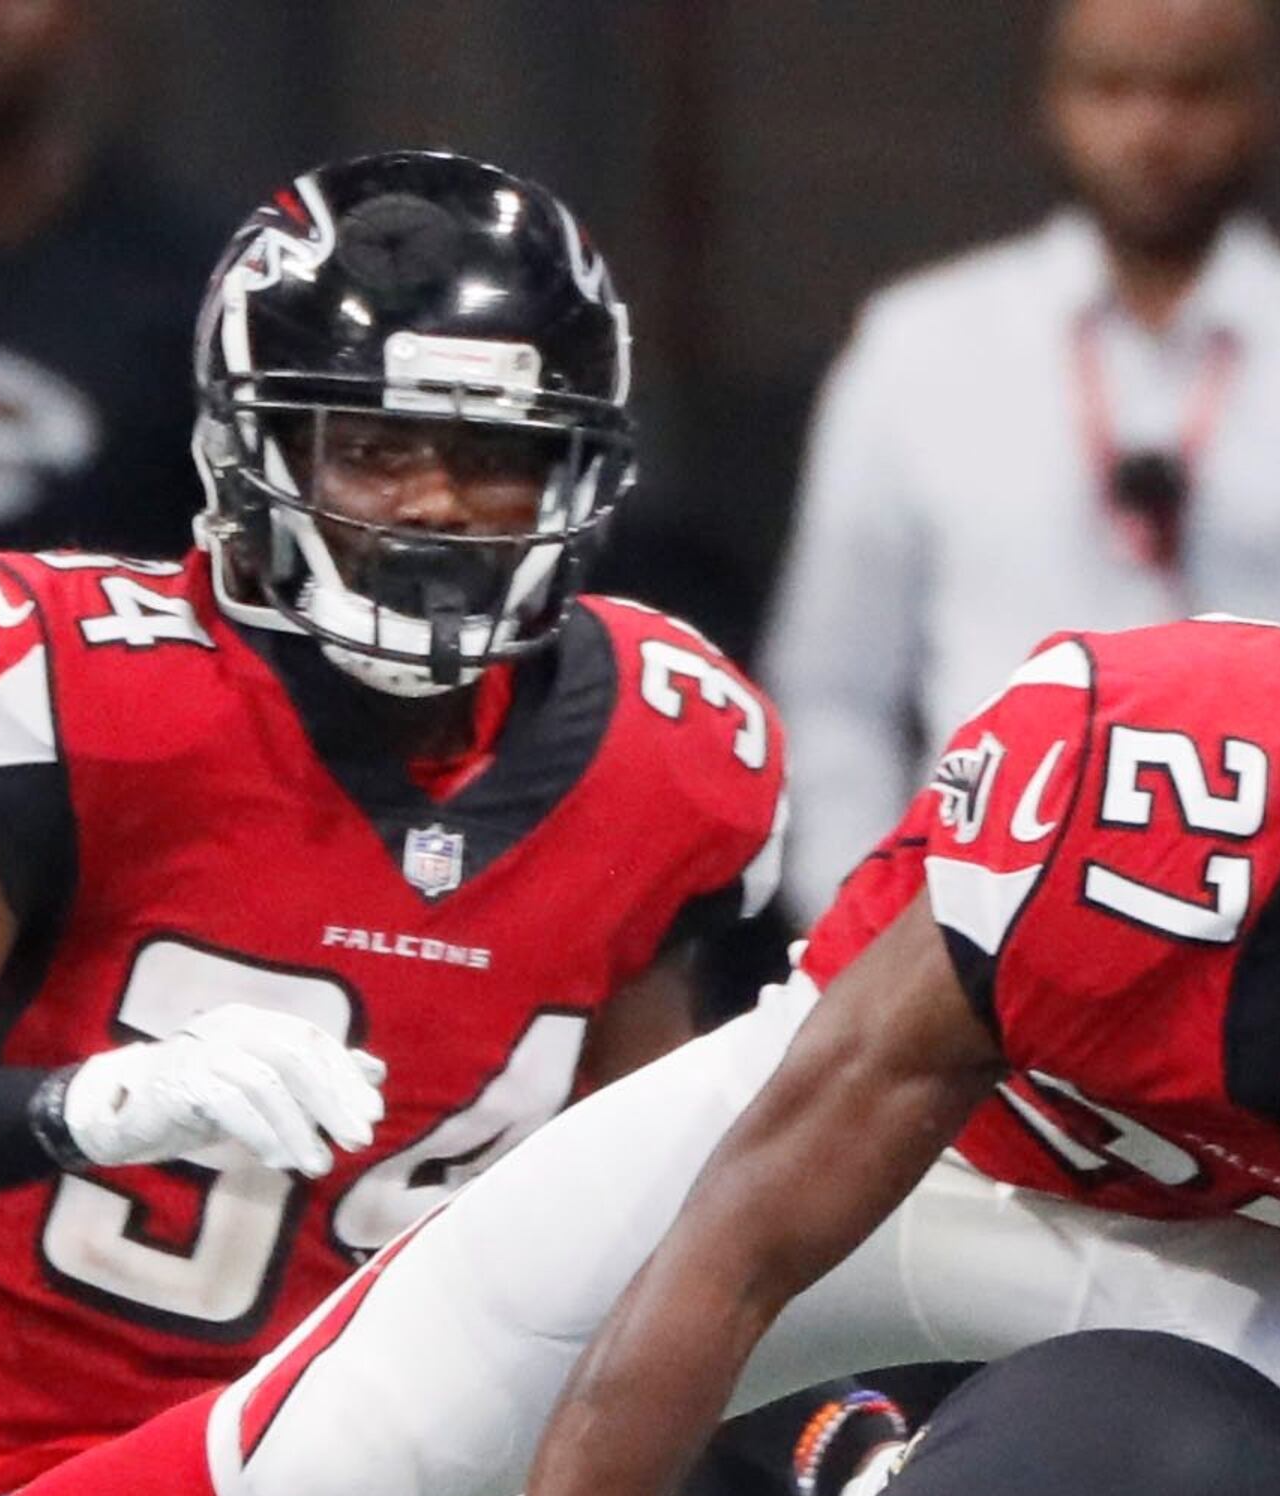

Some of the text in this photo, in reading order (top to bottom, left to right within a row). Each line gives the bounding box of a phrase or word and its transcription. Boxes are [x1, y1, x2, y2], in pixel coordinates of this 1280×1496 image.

[32, 551, 217, 648] 4
[1083, 723, 1269, 943] 27
[321, 924, 492, 971] FALCONS
